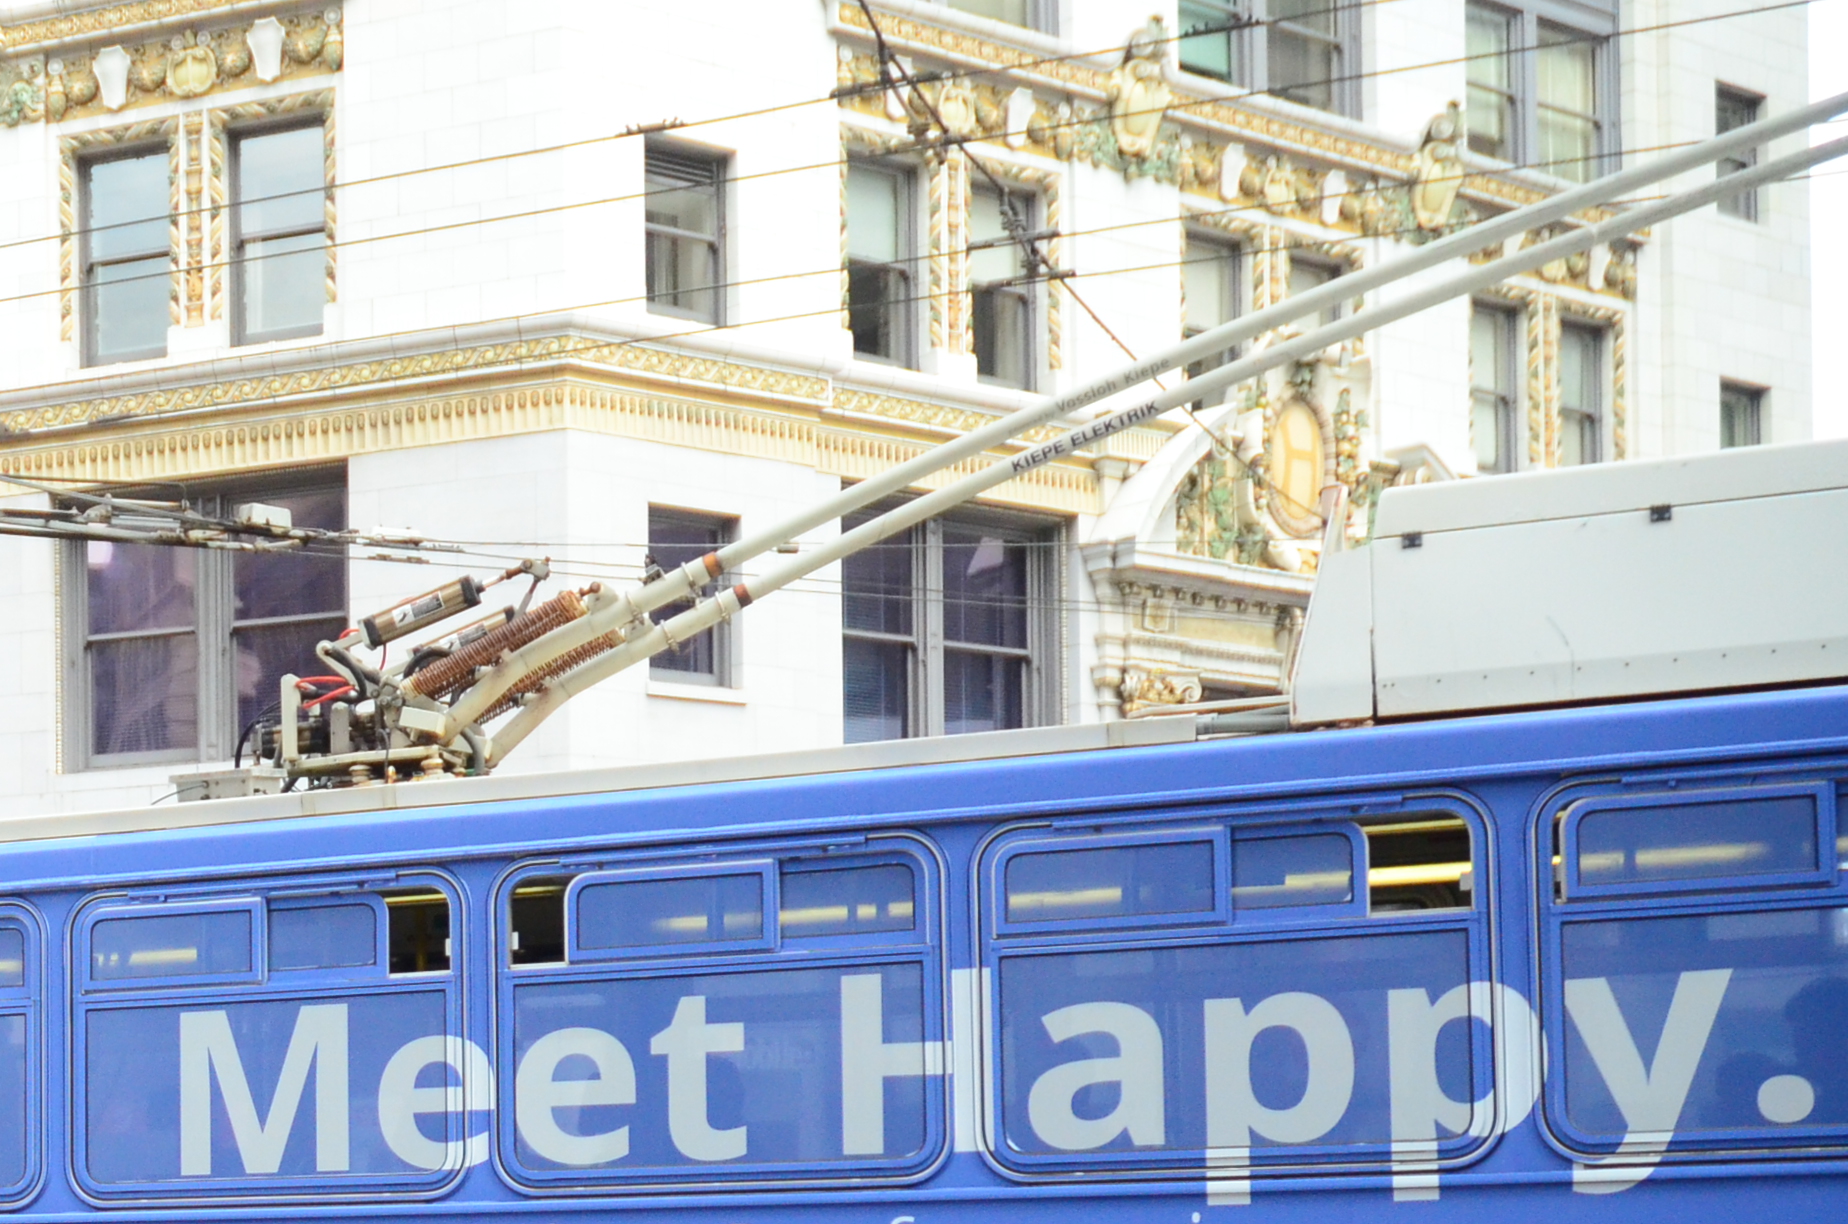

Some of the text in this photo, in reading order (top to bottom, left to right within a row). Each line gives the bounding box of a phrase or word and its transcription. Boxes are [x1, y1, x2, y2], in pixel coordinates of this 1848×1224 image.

[1056, 381, 1117, 412] Vossloh
[1123, 357, 1170, 384] Kiepe
[1011, 401, 1159, 473] KIEPE ELEKTRIK
[179, 967, 1815, 1207] Meet Happy.
